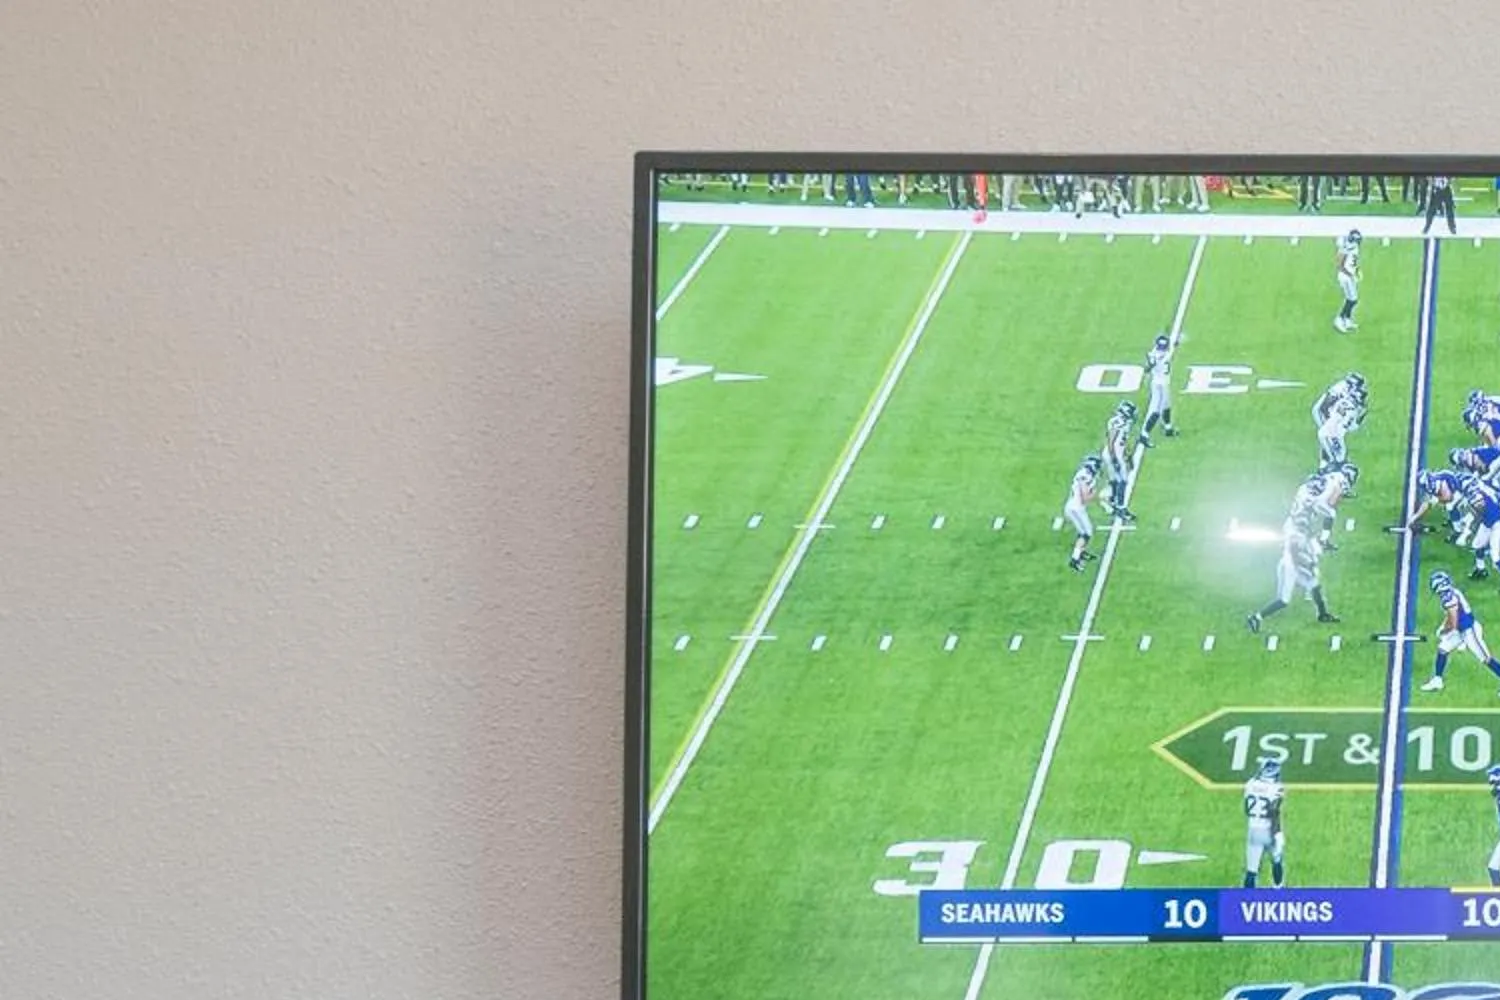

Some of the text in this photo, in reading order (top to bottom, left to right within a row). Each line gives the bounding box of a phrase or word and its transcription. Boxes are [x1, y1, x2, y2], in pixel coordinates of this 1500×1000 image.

[1222, 725, 1492, 771] 1ST & 10
[940, 899, 1208, 929] SEAHAWKS 10
[1240, 901, 1334, 923] VIKINGS
